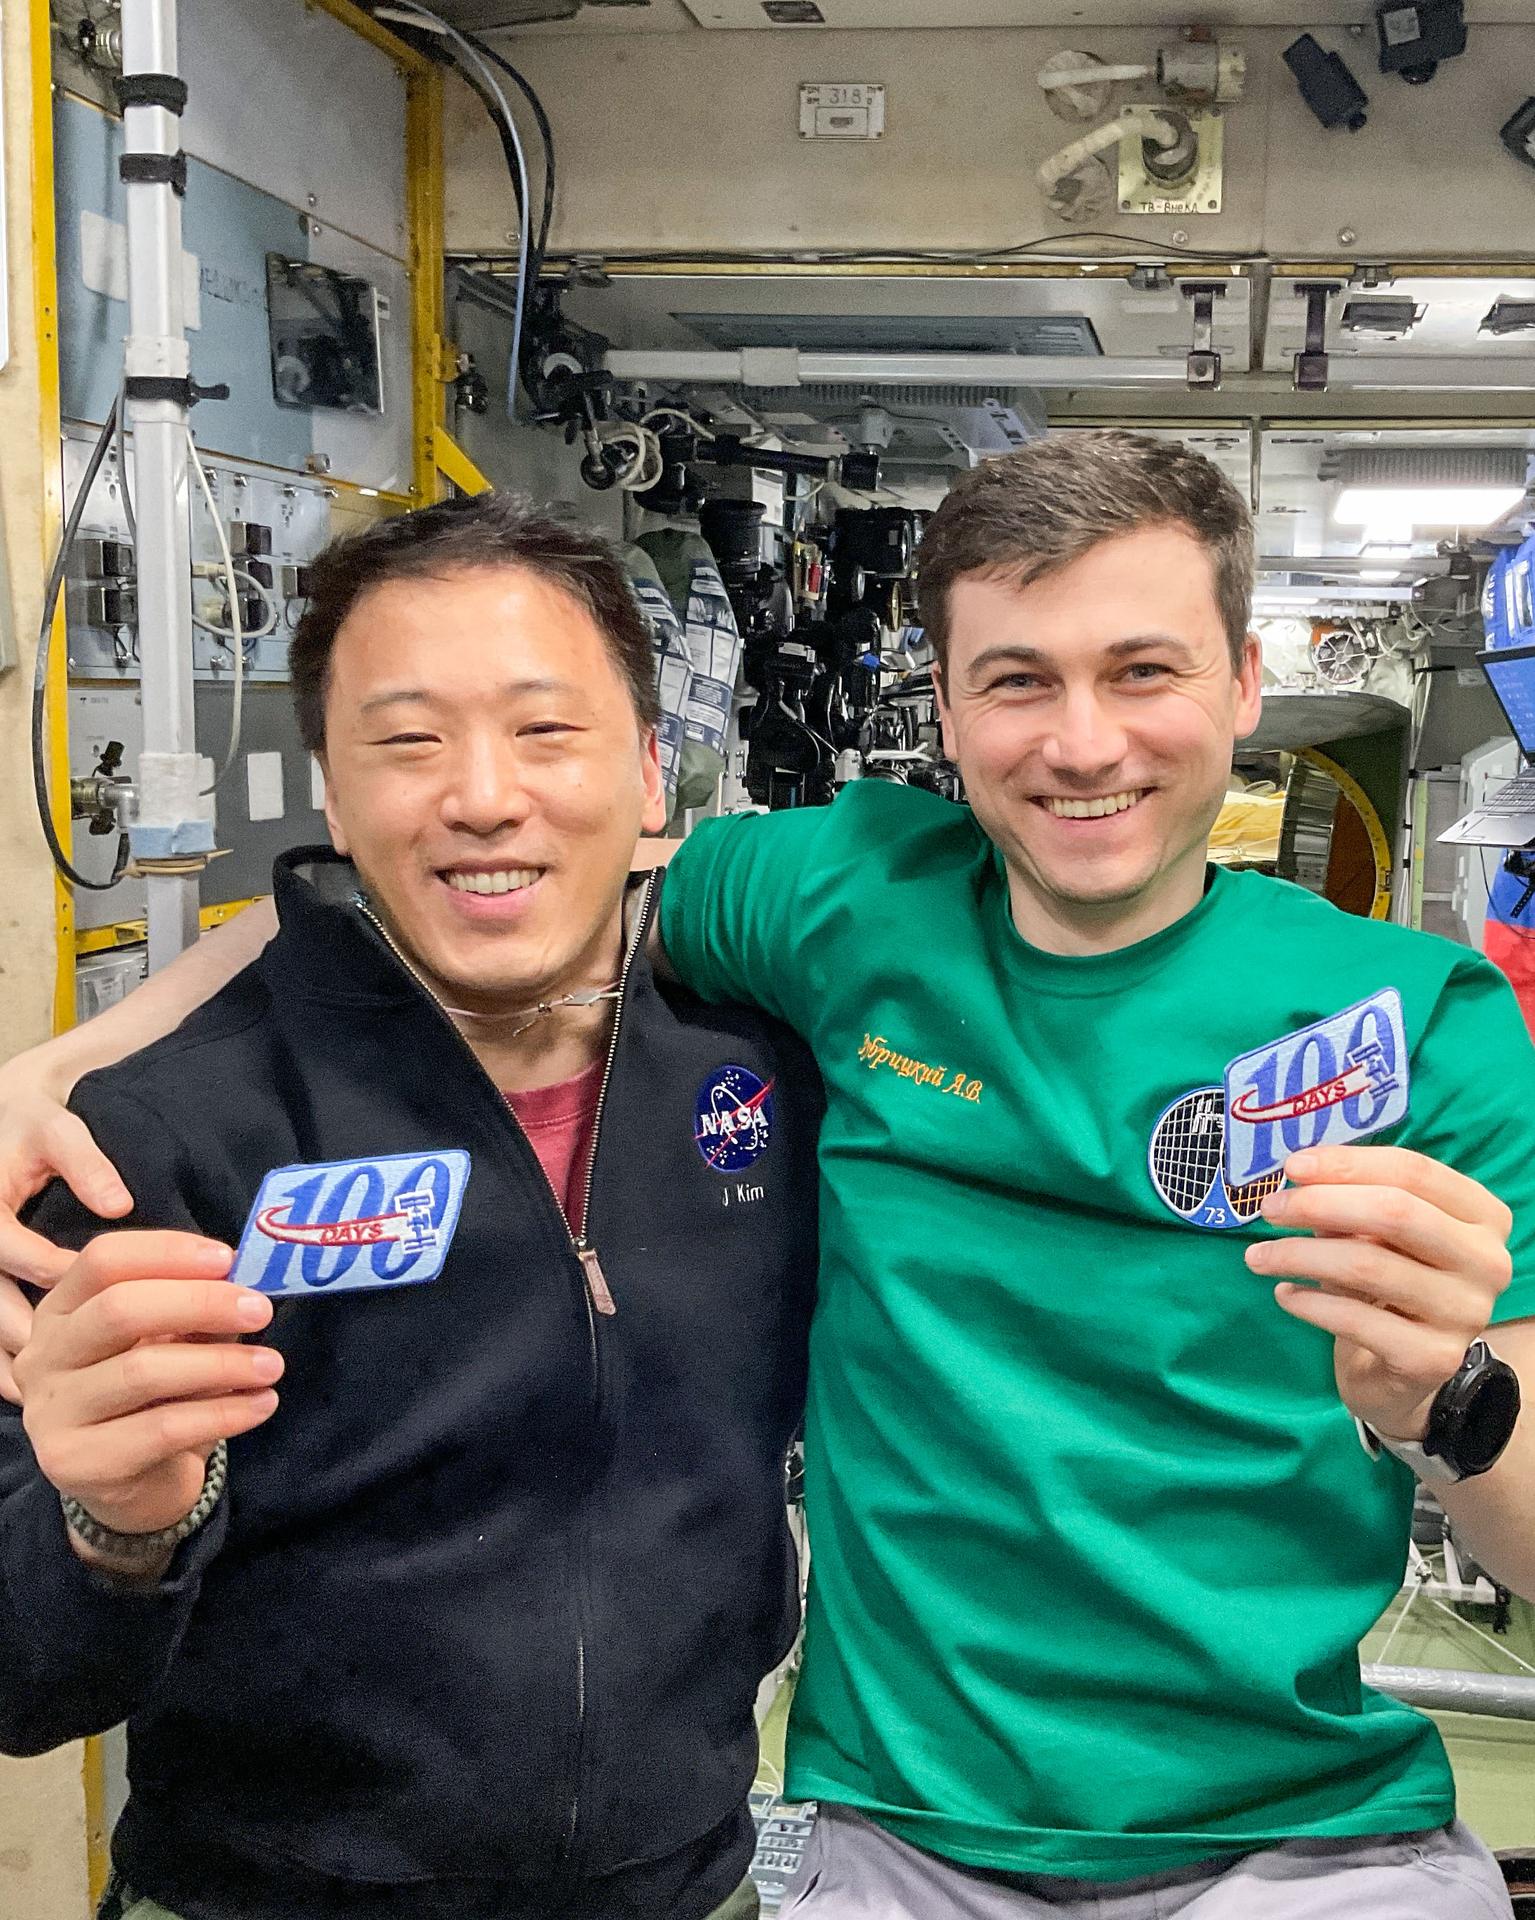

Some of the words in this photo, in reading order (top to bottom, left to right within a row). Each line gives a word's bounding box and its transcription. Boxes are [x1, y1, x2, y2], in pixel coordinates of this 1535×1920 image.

[829, 86, 861, 104] 318
[1241, 1004, 1396, 1178] 100
[1292, 1080, 1347, 1115] DAYS
[700, 1106, 769, 1136] NASA
[722, 1187, 729, 1207] J
[736, 1184, 764, 1203] Kim
[251, 1158, 450, 1291] 100
[1204, 1206, 1226, 1224] 73
[320, 1222, 385, 1244] DAYS
